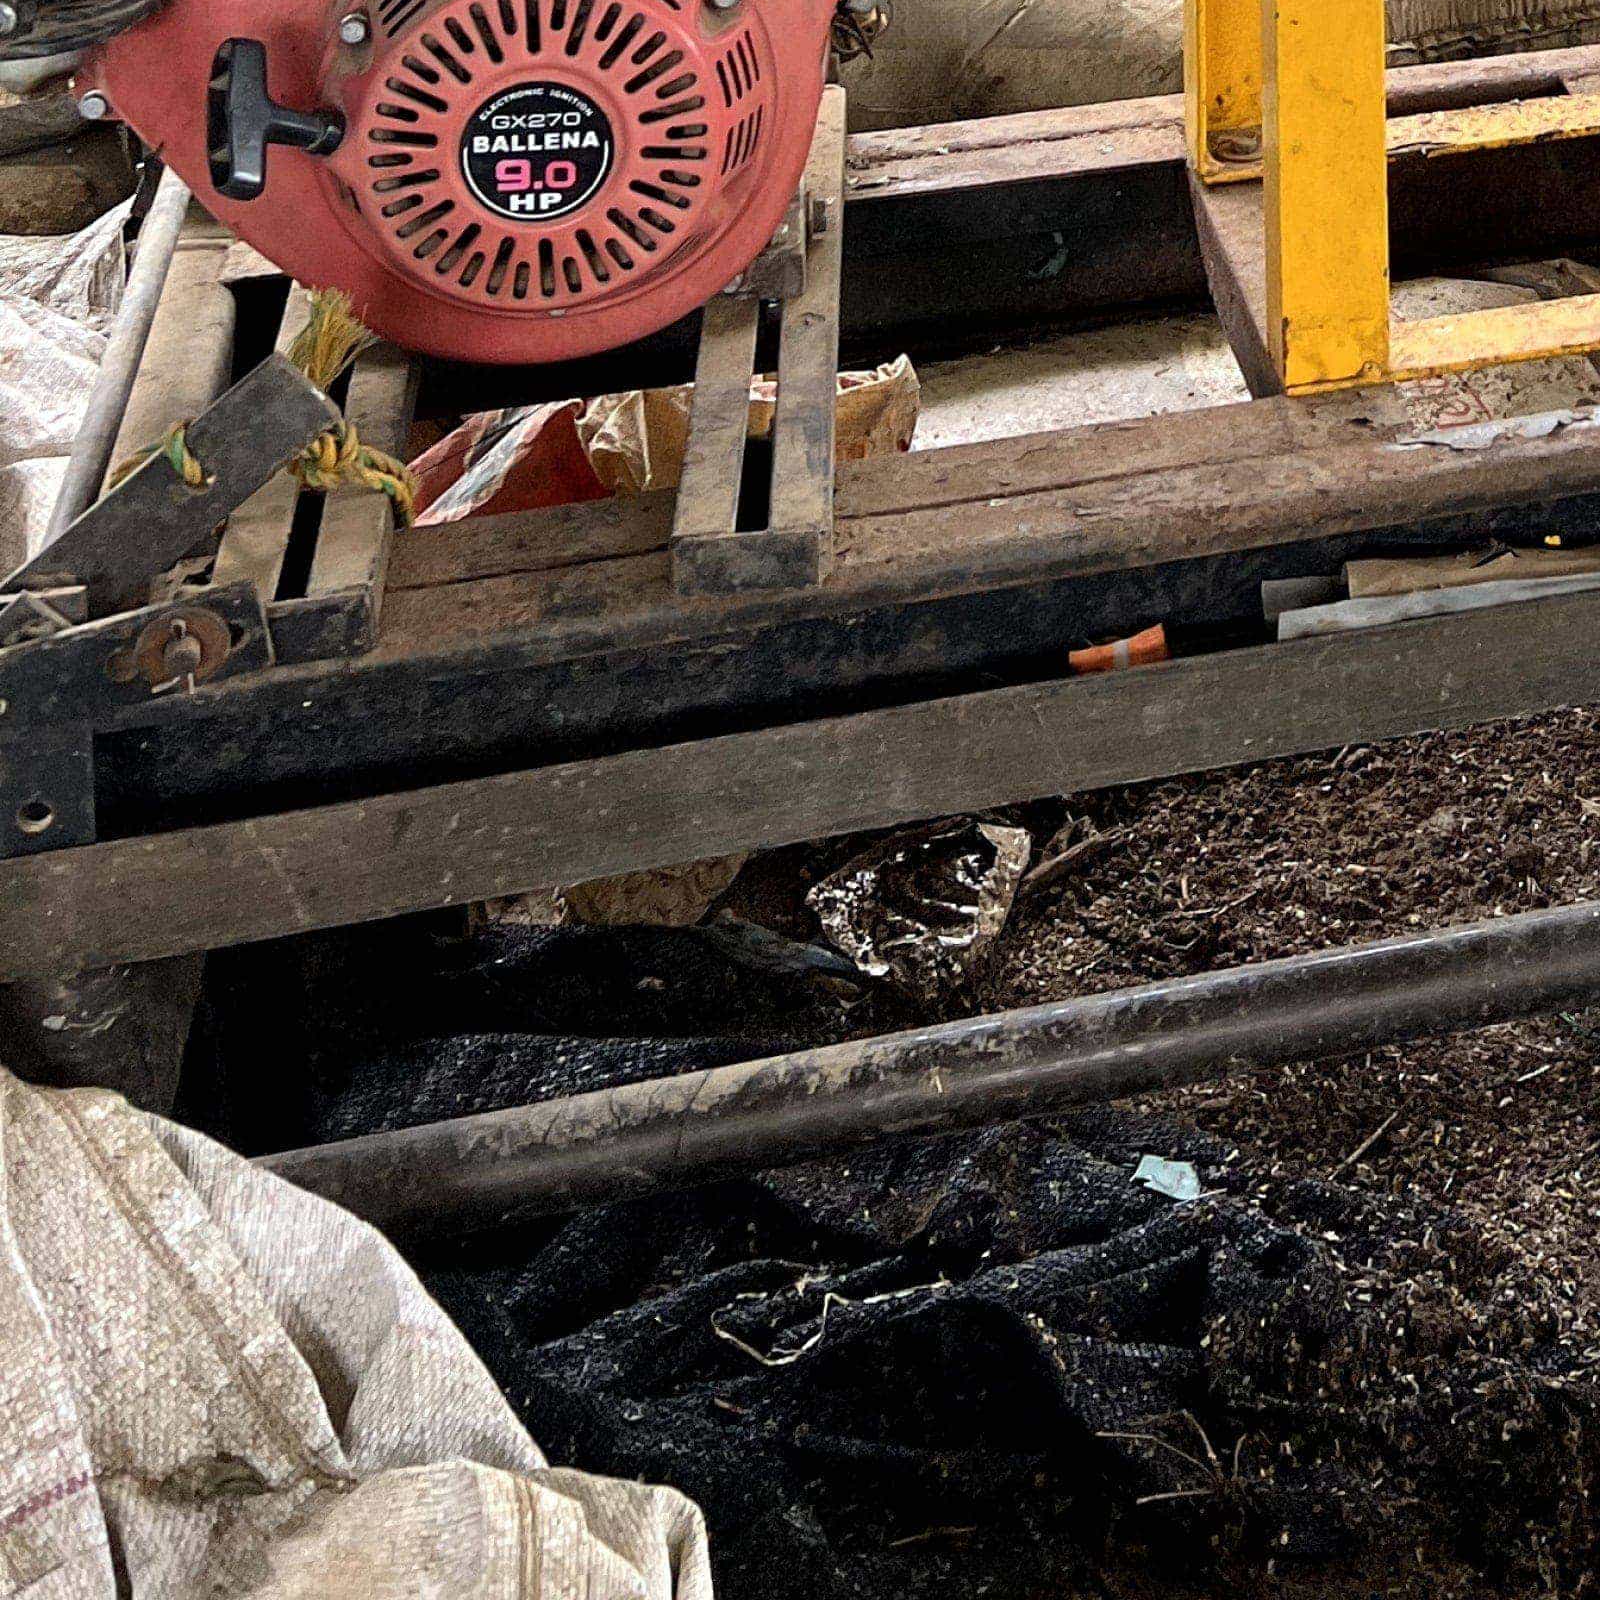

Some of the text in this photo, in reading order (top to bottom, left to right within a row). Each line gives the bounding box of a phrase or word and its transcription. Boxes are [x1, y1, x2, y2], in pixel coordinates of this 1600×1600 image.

[479, 88, 594, 121] ELECTRONIC IGNITION
[492, 112, 581, 129] GX270
[473, 131, 600, 153] BALLENA
[495, 159, 576, 191] 9.0
[509, 192, 562, 211] HP
